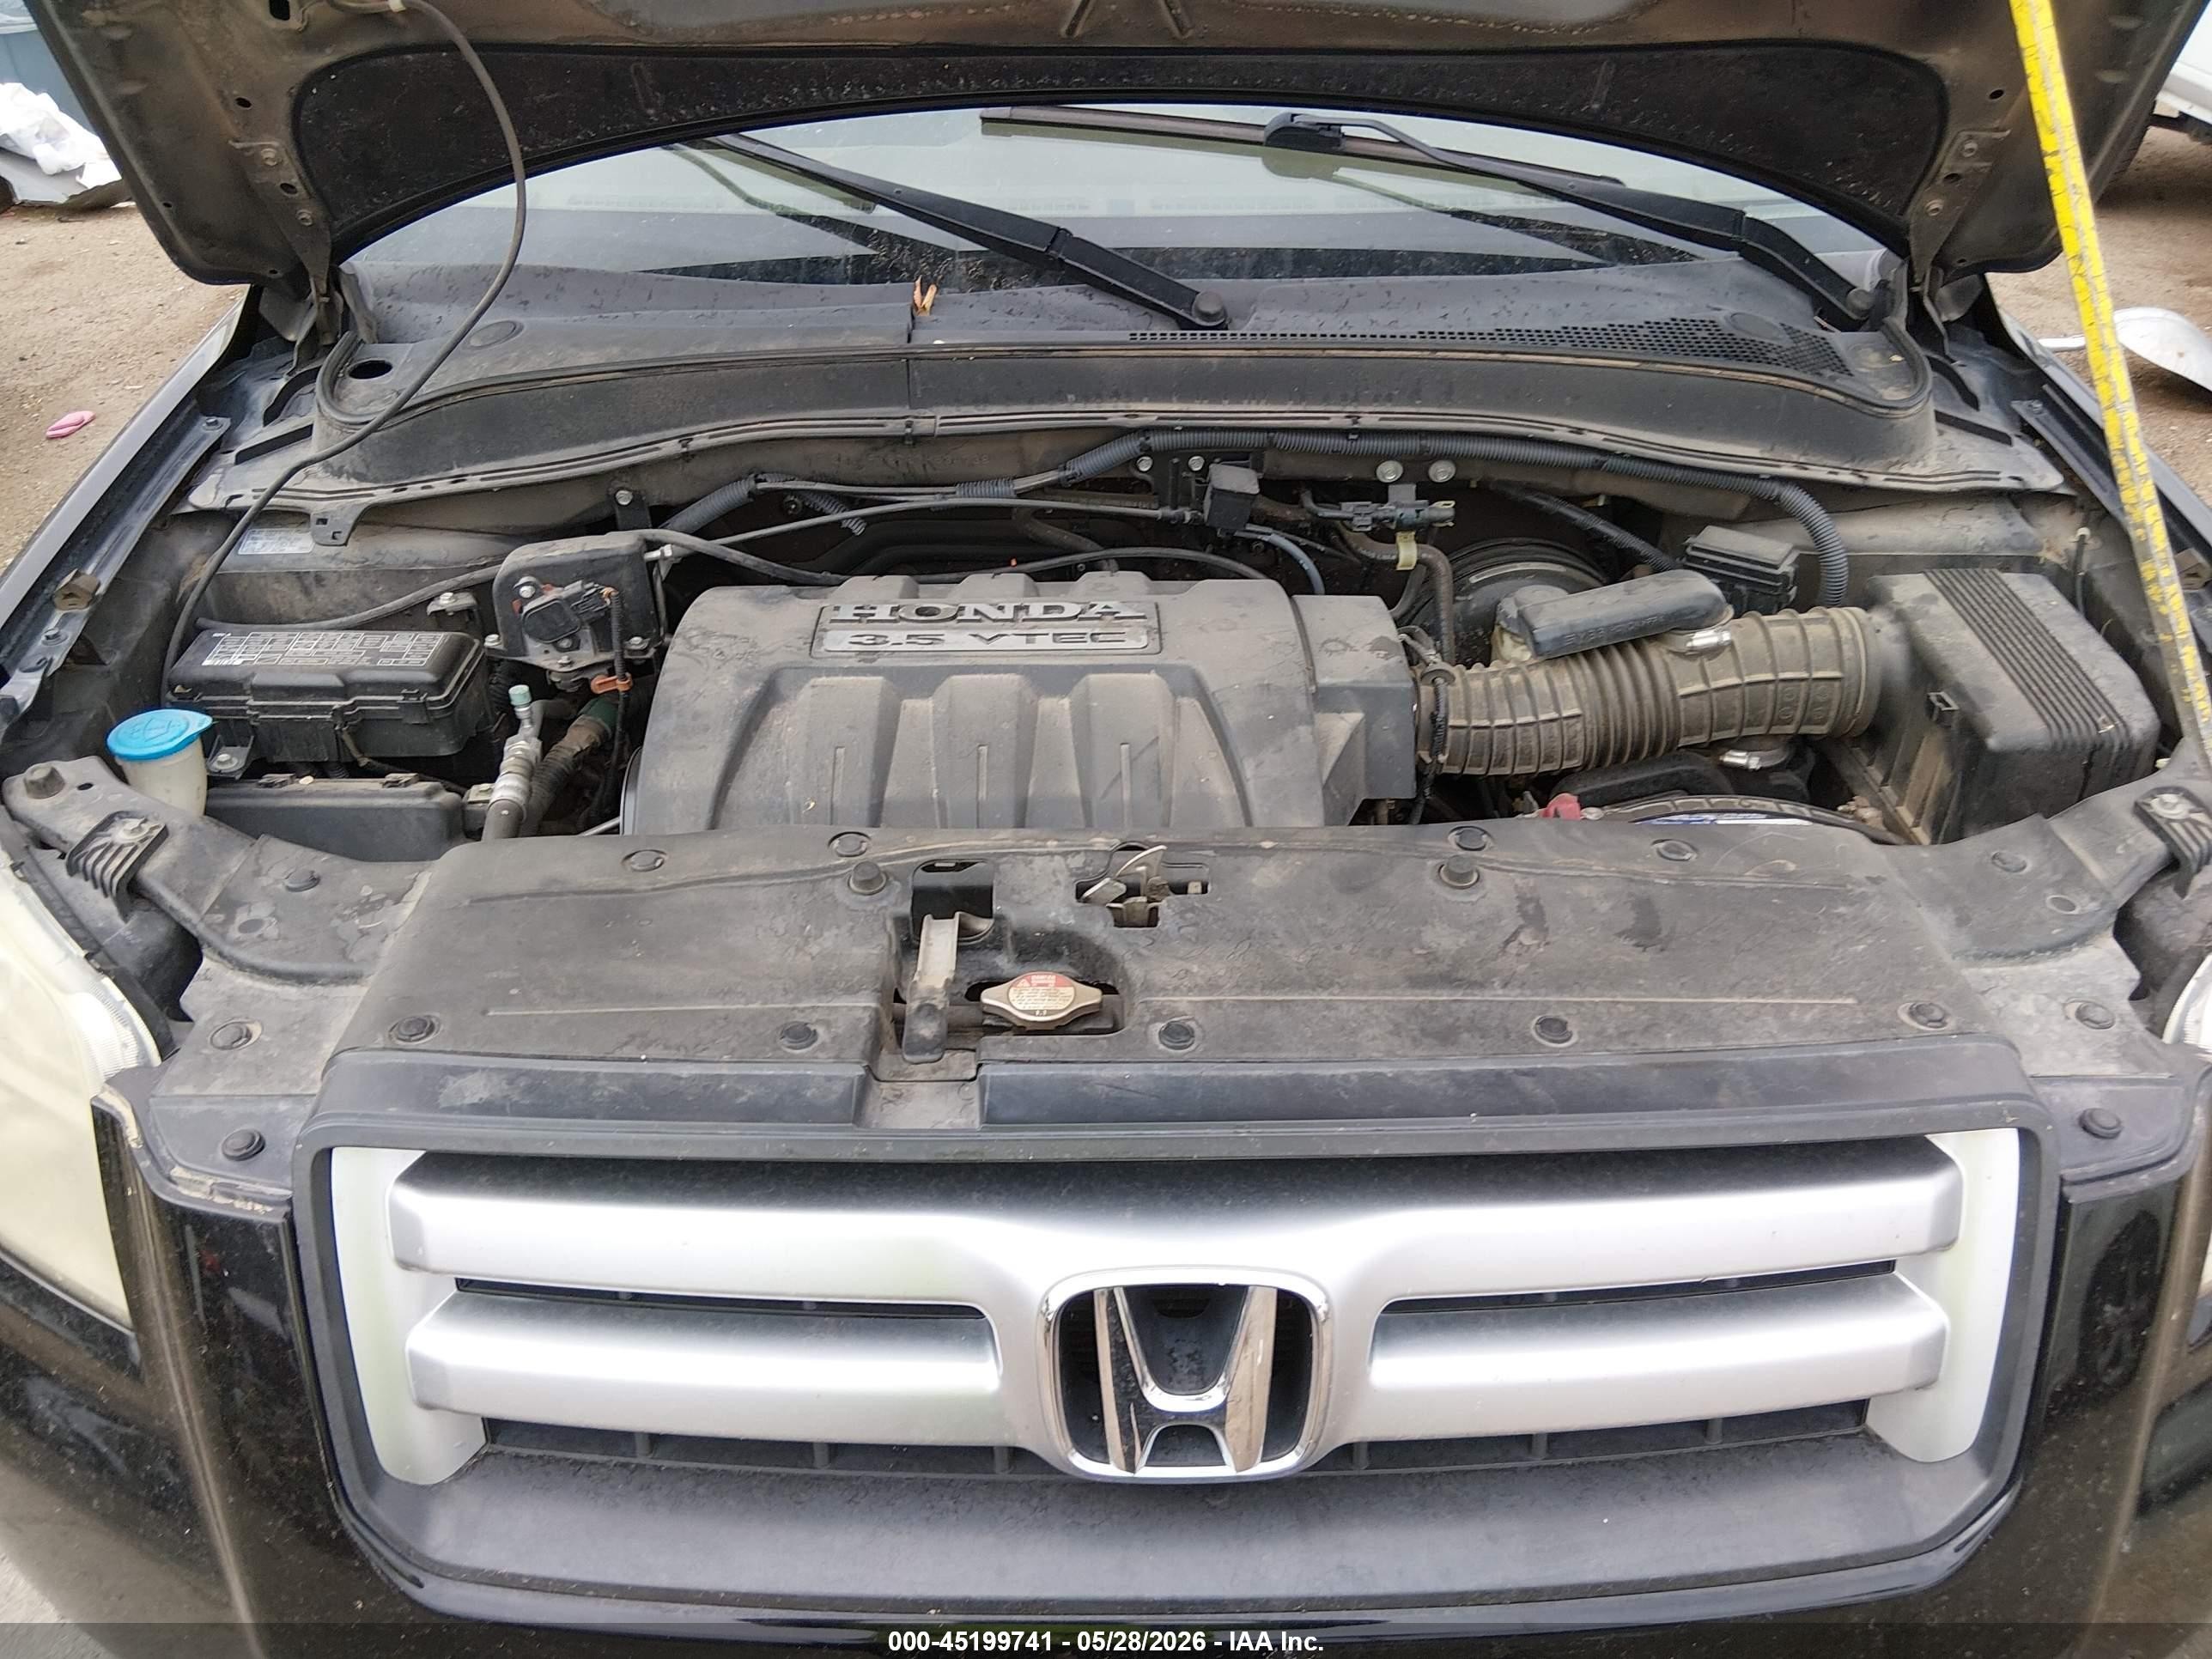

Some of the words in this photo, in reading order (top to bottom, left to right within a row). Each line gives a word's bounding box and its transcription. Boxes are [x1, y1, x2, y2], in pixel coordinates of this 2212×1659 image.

[829, 601, 1149, 624] HONDA
[848, 633, 945, 647] 3.5
[967, 631, 1128, 646] VTEC
